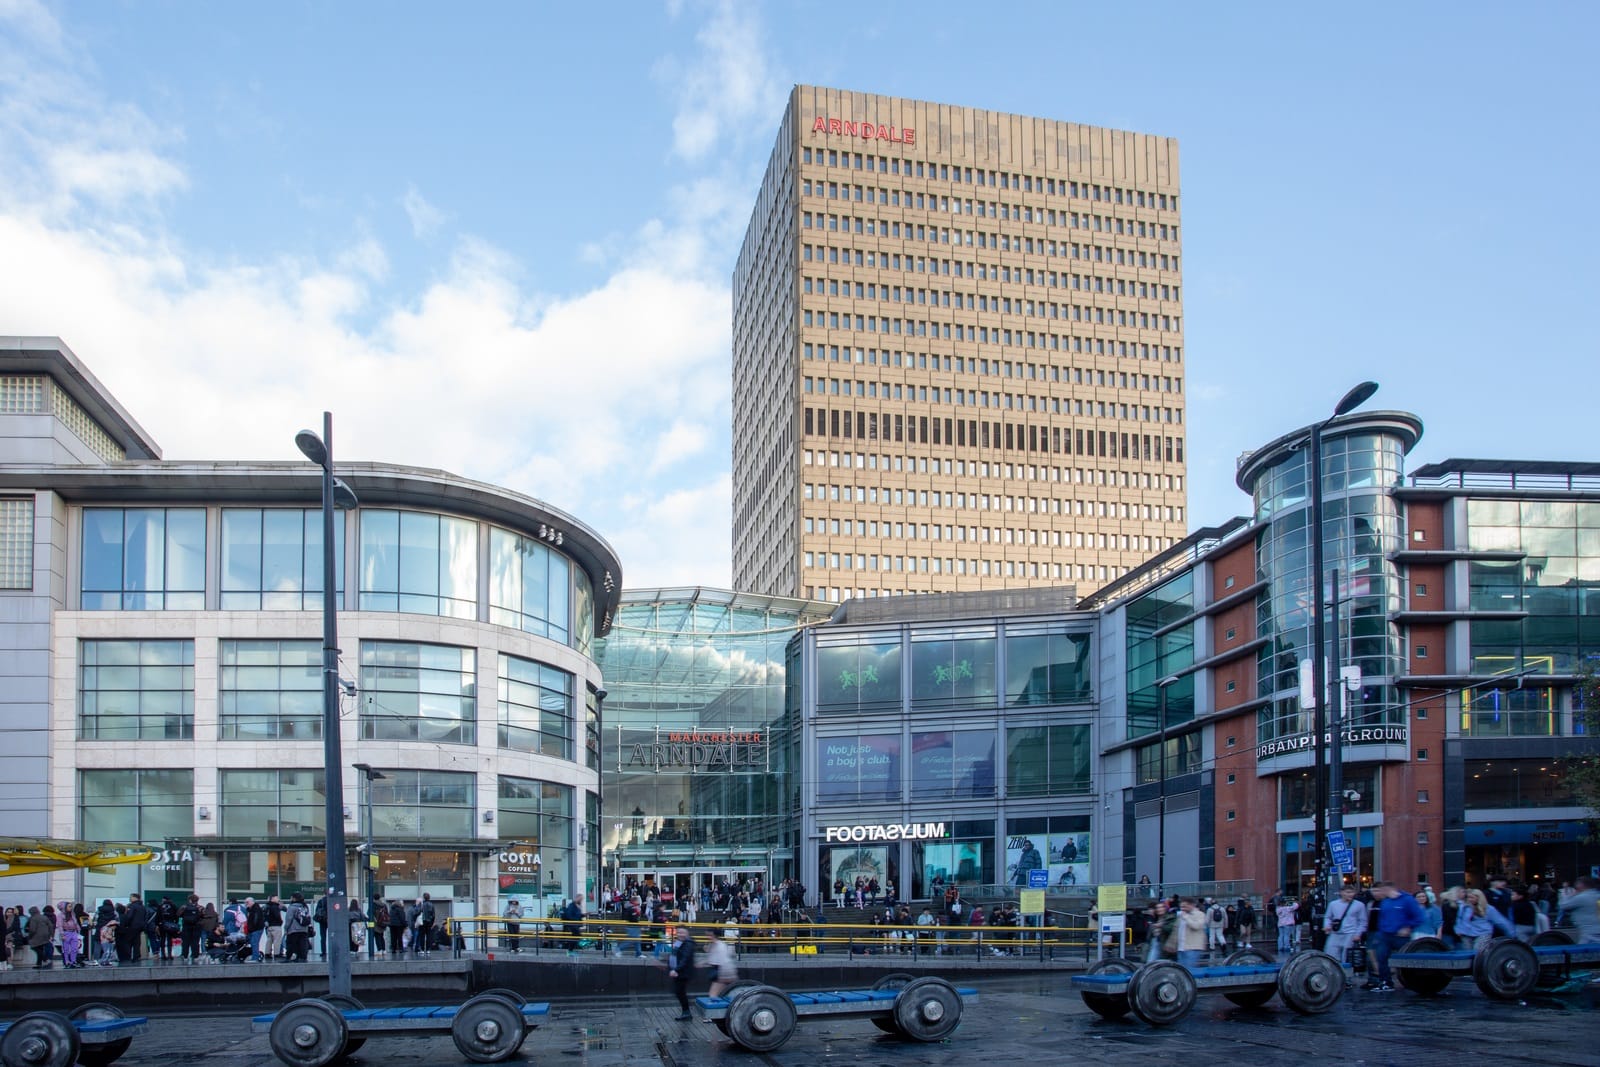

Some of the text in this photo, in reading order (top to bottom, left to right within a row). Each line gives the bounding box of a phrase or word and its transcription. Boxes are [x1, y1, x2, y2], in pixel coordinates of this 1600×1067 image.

[813, 117, 915, 145] ARNDALE
[669, 732, 760, 743] MANCHESTER
[630, 743, 761, 766] ARNDALE
[827, 746, 847, 755] Not
[836, 757, 864, 768] boys
[146, 850, 192, 863] OSTA
[499, 852, 541, 865] COSTA
